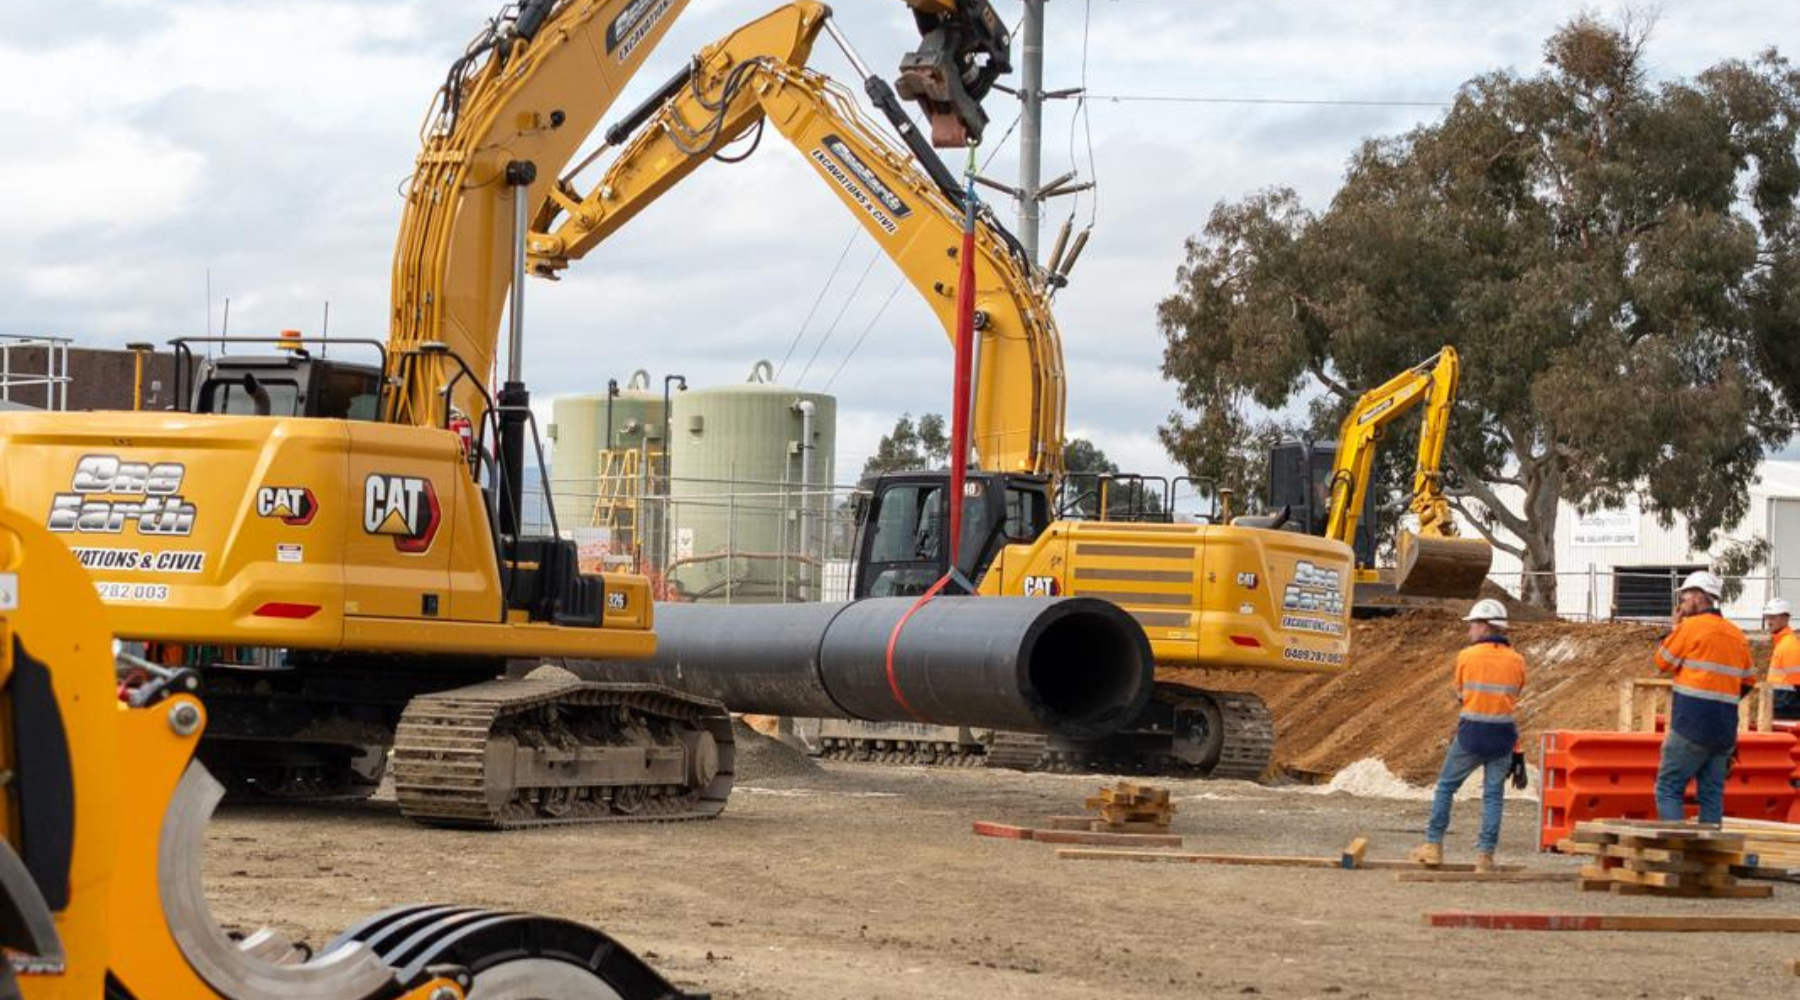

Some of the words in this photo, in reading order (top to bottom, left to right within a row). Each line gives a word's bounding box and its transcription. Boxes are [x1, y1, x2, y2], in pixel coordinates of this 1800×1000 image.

[812, 149, 868, 203] EXCAVATIONS
[873, 210, 896, 232] CIVIL
[73, 454, 185, 494] One
[47, 492, 197, 536] Earth
[257, 487, 304, 518] CAT
[365, 474, 424, 535] CAT
[72, 549, 138, 568] VATIONS
[140, 554, 153, 570] &
[157, 552, 204, 571] CIVIL
[134, 585, 168, 600] 003
[1024, 577, 1053, 596] CAT
[1237, 572, 1256, 588] CAT
